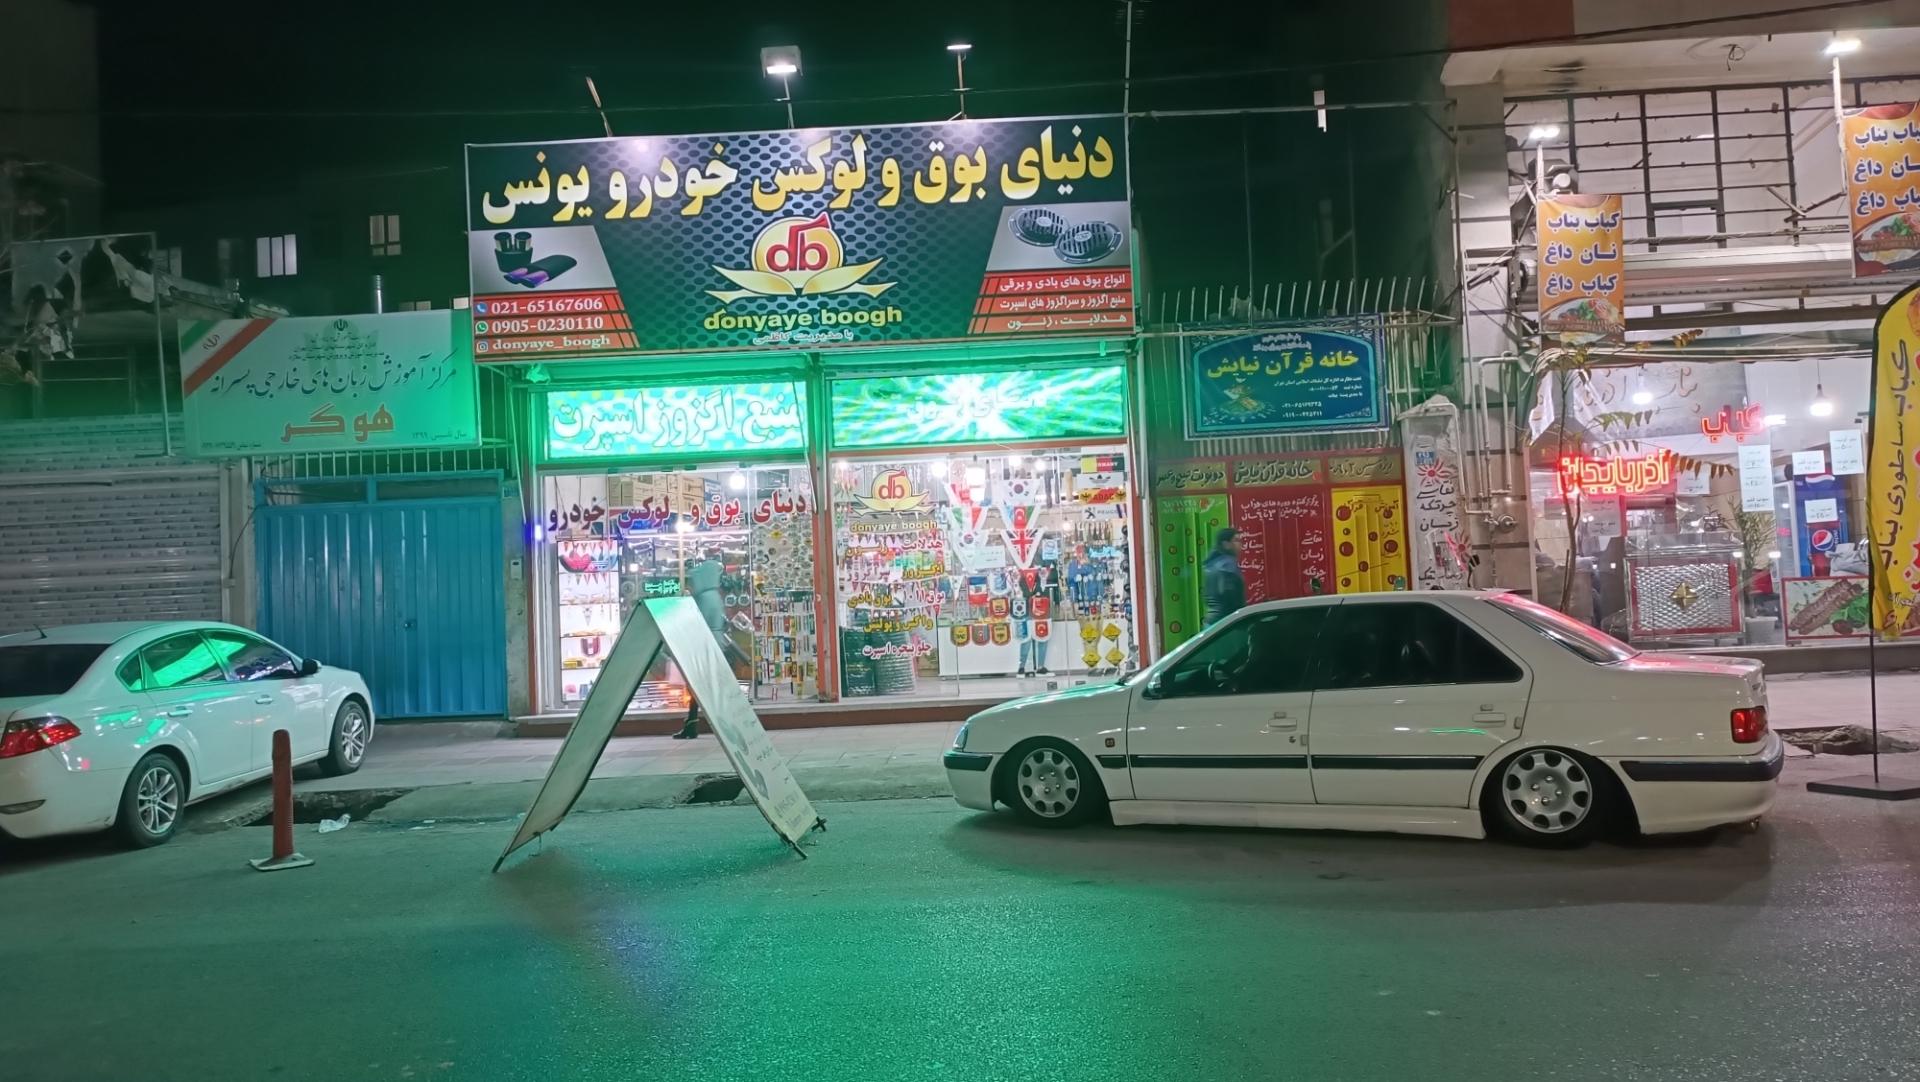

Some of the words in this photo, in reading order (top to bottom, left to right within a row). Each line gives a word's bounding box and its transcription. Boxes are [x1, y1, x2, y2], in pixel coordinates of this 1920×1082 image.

[1855, 126, 1888, 148] بناب
[752, 133, 867, 211] لوکس
[914, 140, 986, 204] بوق
[1001, 125, 1113, 200] دنیای
[1854, 160, 1884, 183] داغ
[482, 151, 590, 224] یونس
[604, 142, 738, 219] خودرو
[877, 157, 900, 207] و
[1857, 192, 1885, 215] داغ
[1548, 212, 1580, 232] بناب
[1584, 212, 1620, 232] کباب
[1545, 242, 1573, 265] داغ
[1580, 243, 1617, 265] نان
[1000, 279, 1024, 292] برقی
[1027, 281, 1033, 290] و
[1035, 277, 1058, 290] بادی
[1061, 276, 1080, 288] های
[1083, 275, 1101, 288] بوق
[1104, 274, 1125, 288] انواع
[1546, 273, 1573, 296] داغ
[1581, 274, 1618, 295] کباب
[491, 297, 603, 314] 021-65167606
[1000, 298, 1027, 311] اسپرت
[1028, 297, 1044, 309] های
[1080, 299, 1085, 308] و
[1087, 294, 1109, 307] اگزوز
[1110, 296, 1126, 309] منبع
[492, 316, 604, 334] 0905-0230110
[704, 308, 812, 332] donyaye
[821, 306, 902, 327] boogh
[493, 335, 610, 352] donyaye_boogh
[753, 331, 790, 345] کاظمی
[795, 331, 841, 343] مدیریت
[844, 329, 854, 341] با
[427, 350, 457, 390] مرکز
[1207, 356, 1260, 378] نیایش
[1265, 351, 1315, 375] قرآن
[1319, 350, 1359, 368] خانه
[210, 369, 255, 393] پسرانه
[254, 367, 300, 398] خارجی
[301, 366, 328, 394] های
[331, 365, 367, 398] زبان
[368, 353, 432, 391] آموزش
[280, 402, 394, 443] هوگر
[552, 391, 645, 450] اسپرت
[653, 387, 734, 447] اگزوز
[742, 392, 804, 443] منبع
[1702, 403, 1764, 443] کباب
[1556, 448, 1670, 496] آذربایجان
[547, 497, 606, 531] خودرو
[616, 495, 671, 529] لوکس
[690, 501, 701, 526] و
[705, 494, 740, 526] بوق
[753, 488, 807, 524] دنیای
[1420, 499, 1457, 516] چرتکه
[850, 521, 898, 534] donyaye
[902, 519, 938, 531] boogh
[1419, 517, 1459, 534] زبان
[1300, 547, 1325, 564] زبان
